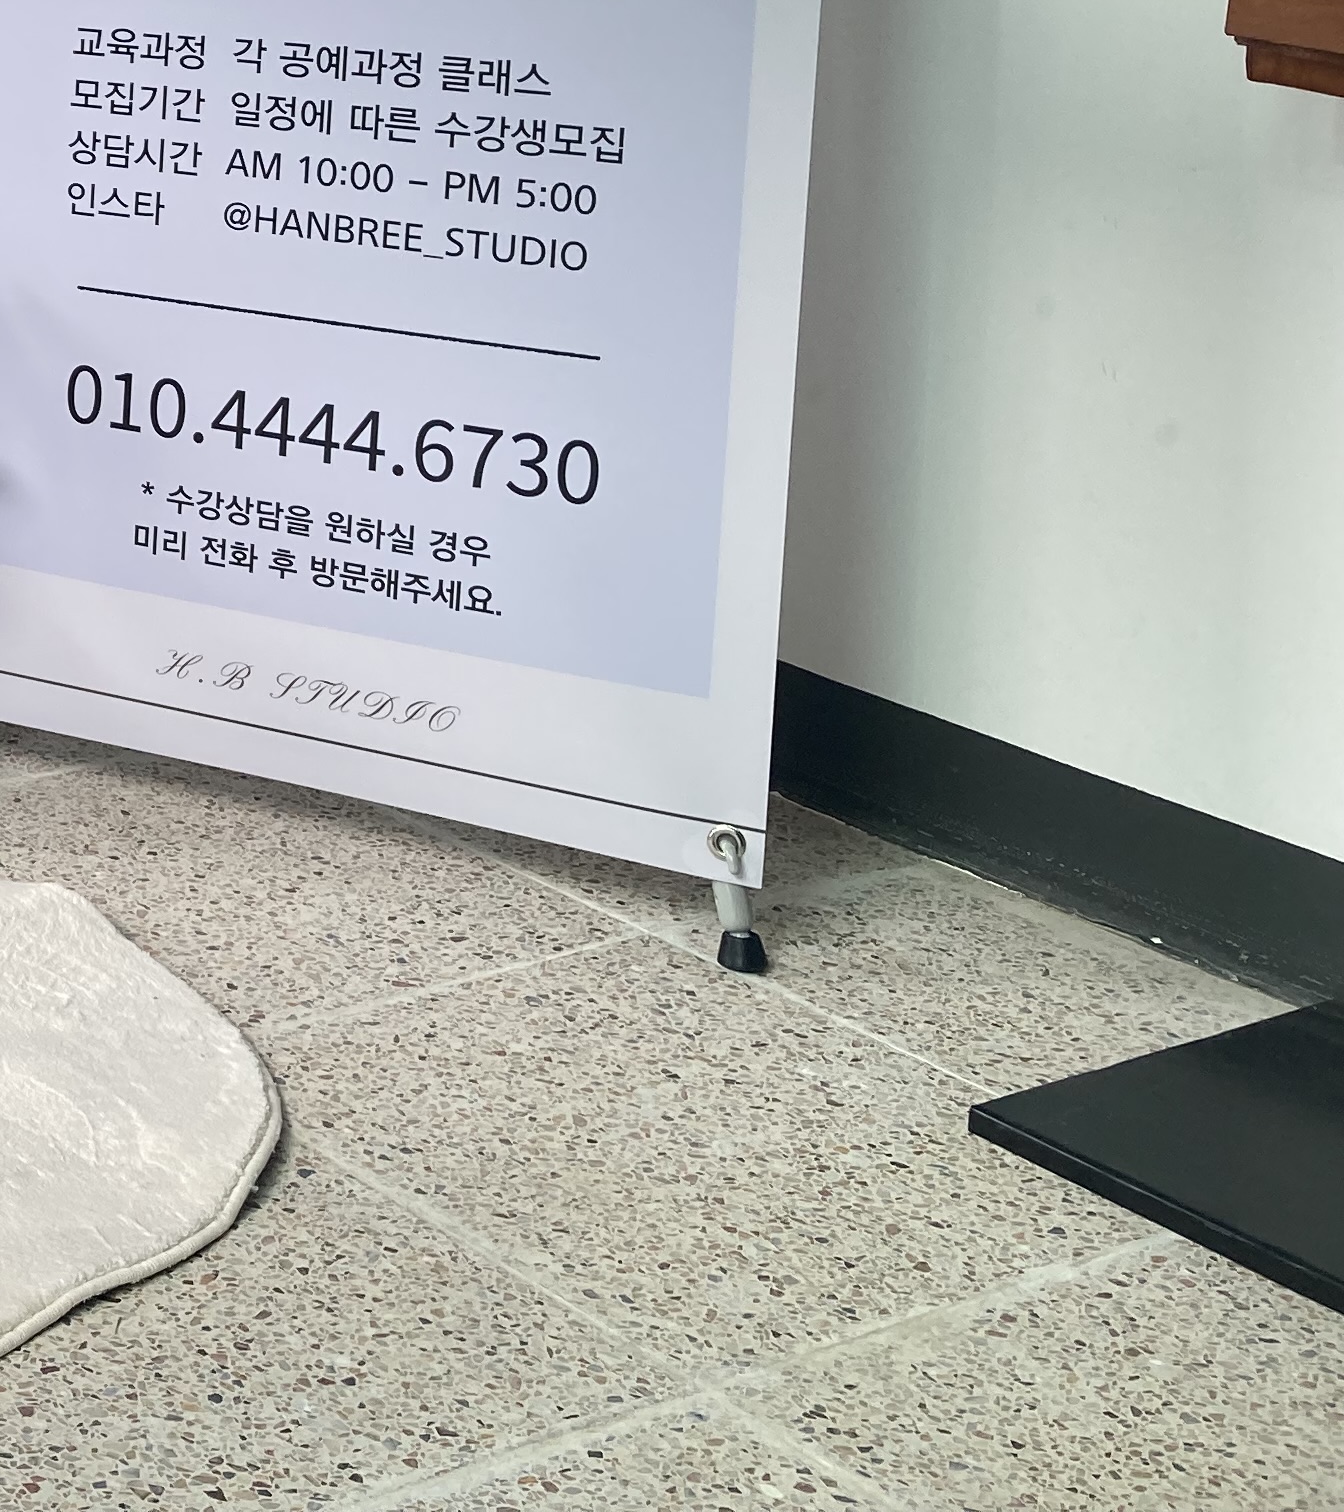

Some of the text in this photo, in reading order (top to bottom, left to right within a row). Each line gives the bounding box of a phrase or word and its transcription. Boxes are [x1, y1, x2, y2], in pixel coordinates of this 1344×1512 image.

[72, 26, 553, 100] 교육과정 각 공예과정 클래스
[69, 78, 628, 166] 모집기간 일정에 따른 수강생모집
[67, 130, 203, 178] 상담시간
[225, 147, 283, 183] AM
[297, 153, 395, 194] 10:00
[443, 170, 501, 206] PM
[516, 179, 598, 216] 5:00
[66, 181, 589, 273] 인스타 @HANBREE_STUDIO
[66, 364, 600, 506] 010.4444.6730
[165, 484, 315, 537] 수강상담을
[324, 512, 416, 555] 원하실
[430, 529, 492, 568] 경우
[132, 523, 504, 619] 미리 전화 후 방문해주세요.
[269, 672, 462, 734] STUDIO
